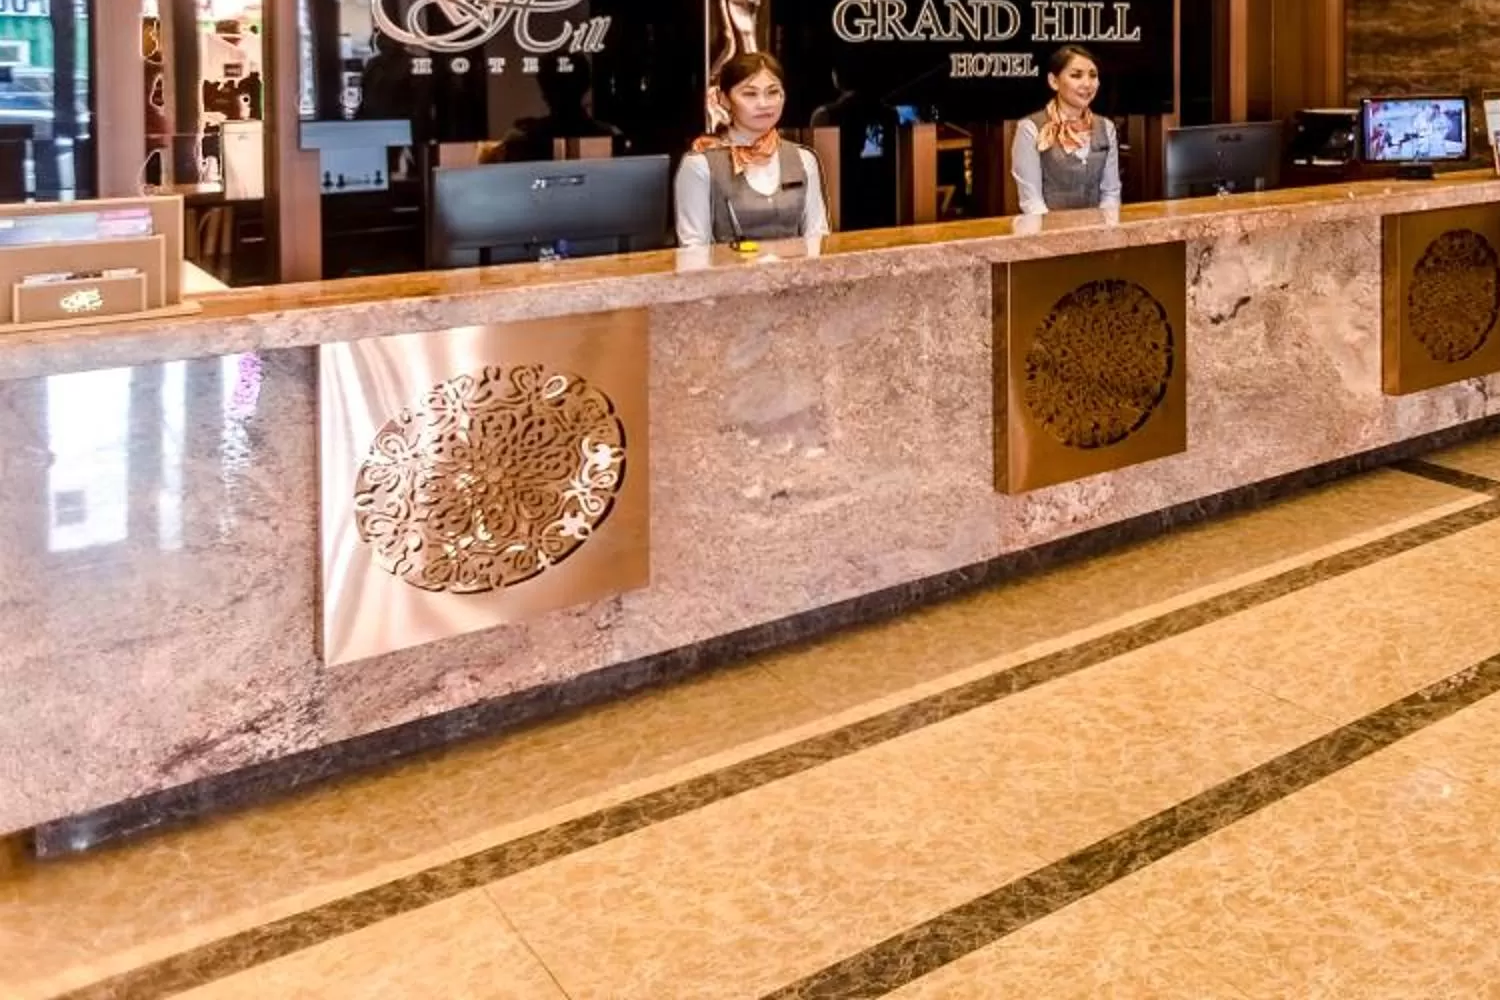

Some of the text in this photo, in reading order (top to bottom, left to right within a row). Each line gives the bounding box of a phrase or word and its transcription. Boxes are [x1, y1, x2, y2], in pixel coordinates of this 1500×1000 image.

[1031, 1, 1141, 42] HILL
[411, 56, 574, 75] HOTEL
[949, 53, 1039, 77] HOTEL
